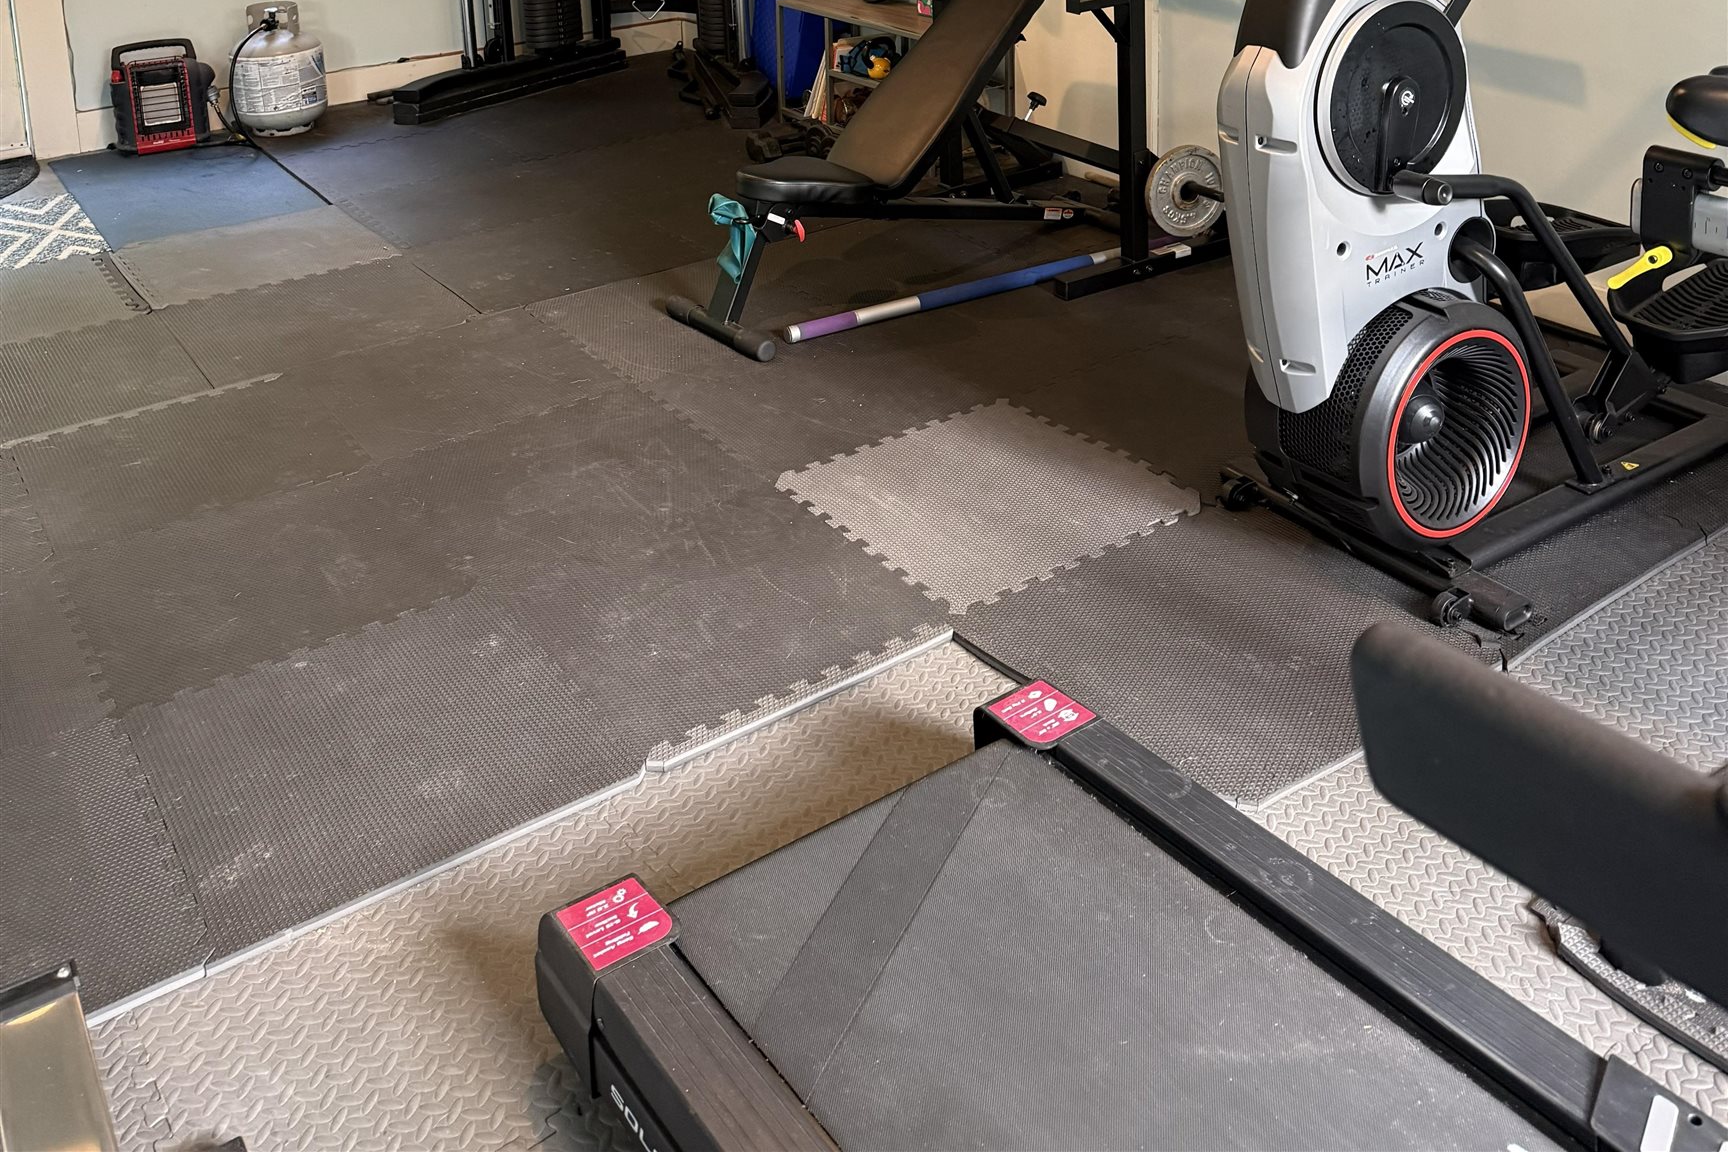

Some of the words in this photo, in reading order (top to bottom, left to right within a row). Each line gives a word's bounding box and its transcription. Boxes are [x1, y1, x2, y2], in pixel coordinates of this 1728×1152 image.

[1366, 241, 1424, 281] MAX
[1367, 259, 1425, 287] TRAINER
[611, 1083, 658, 1152] SOL
